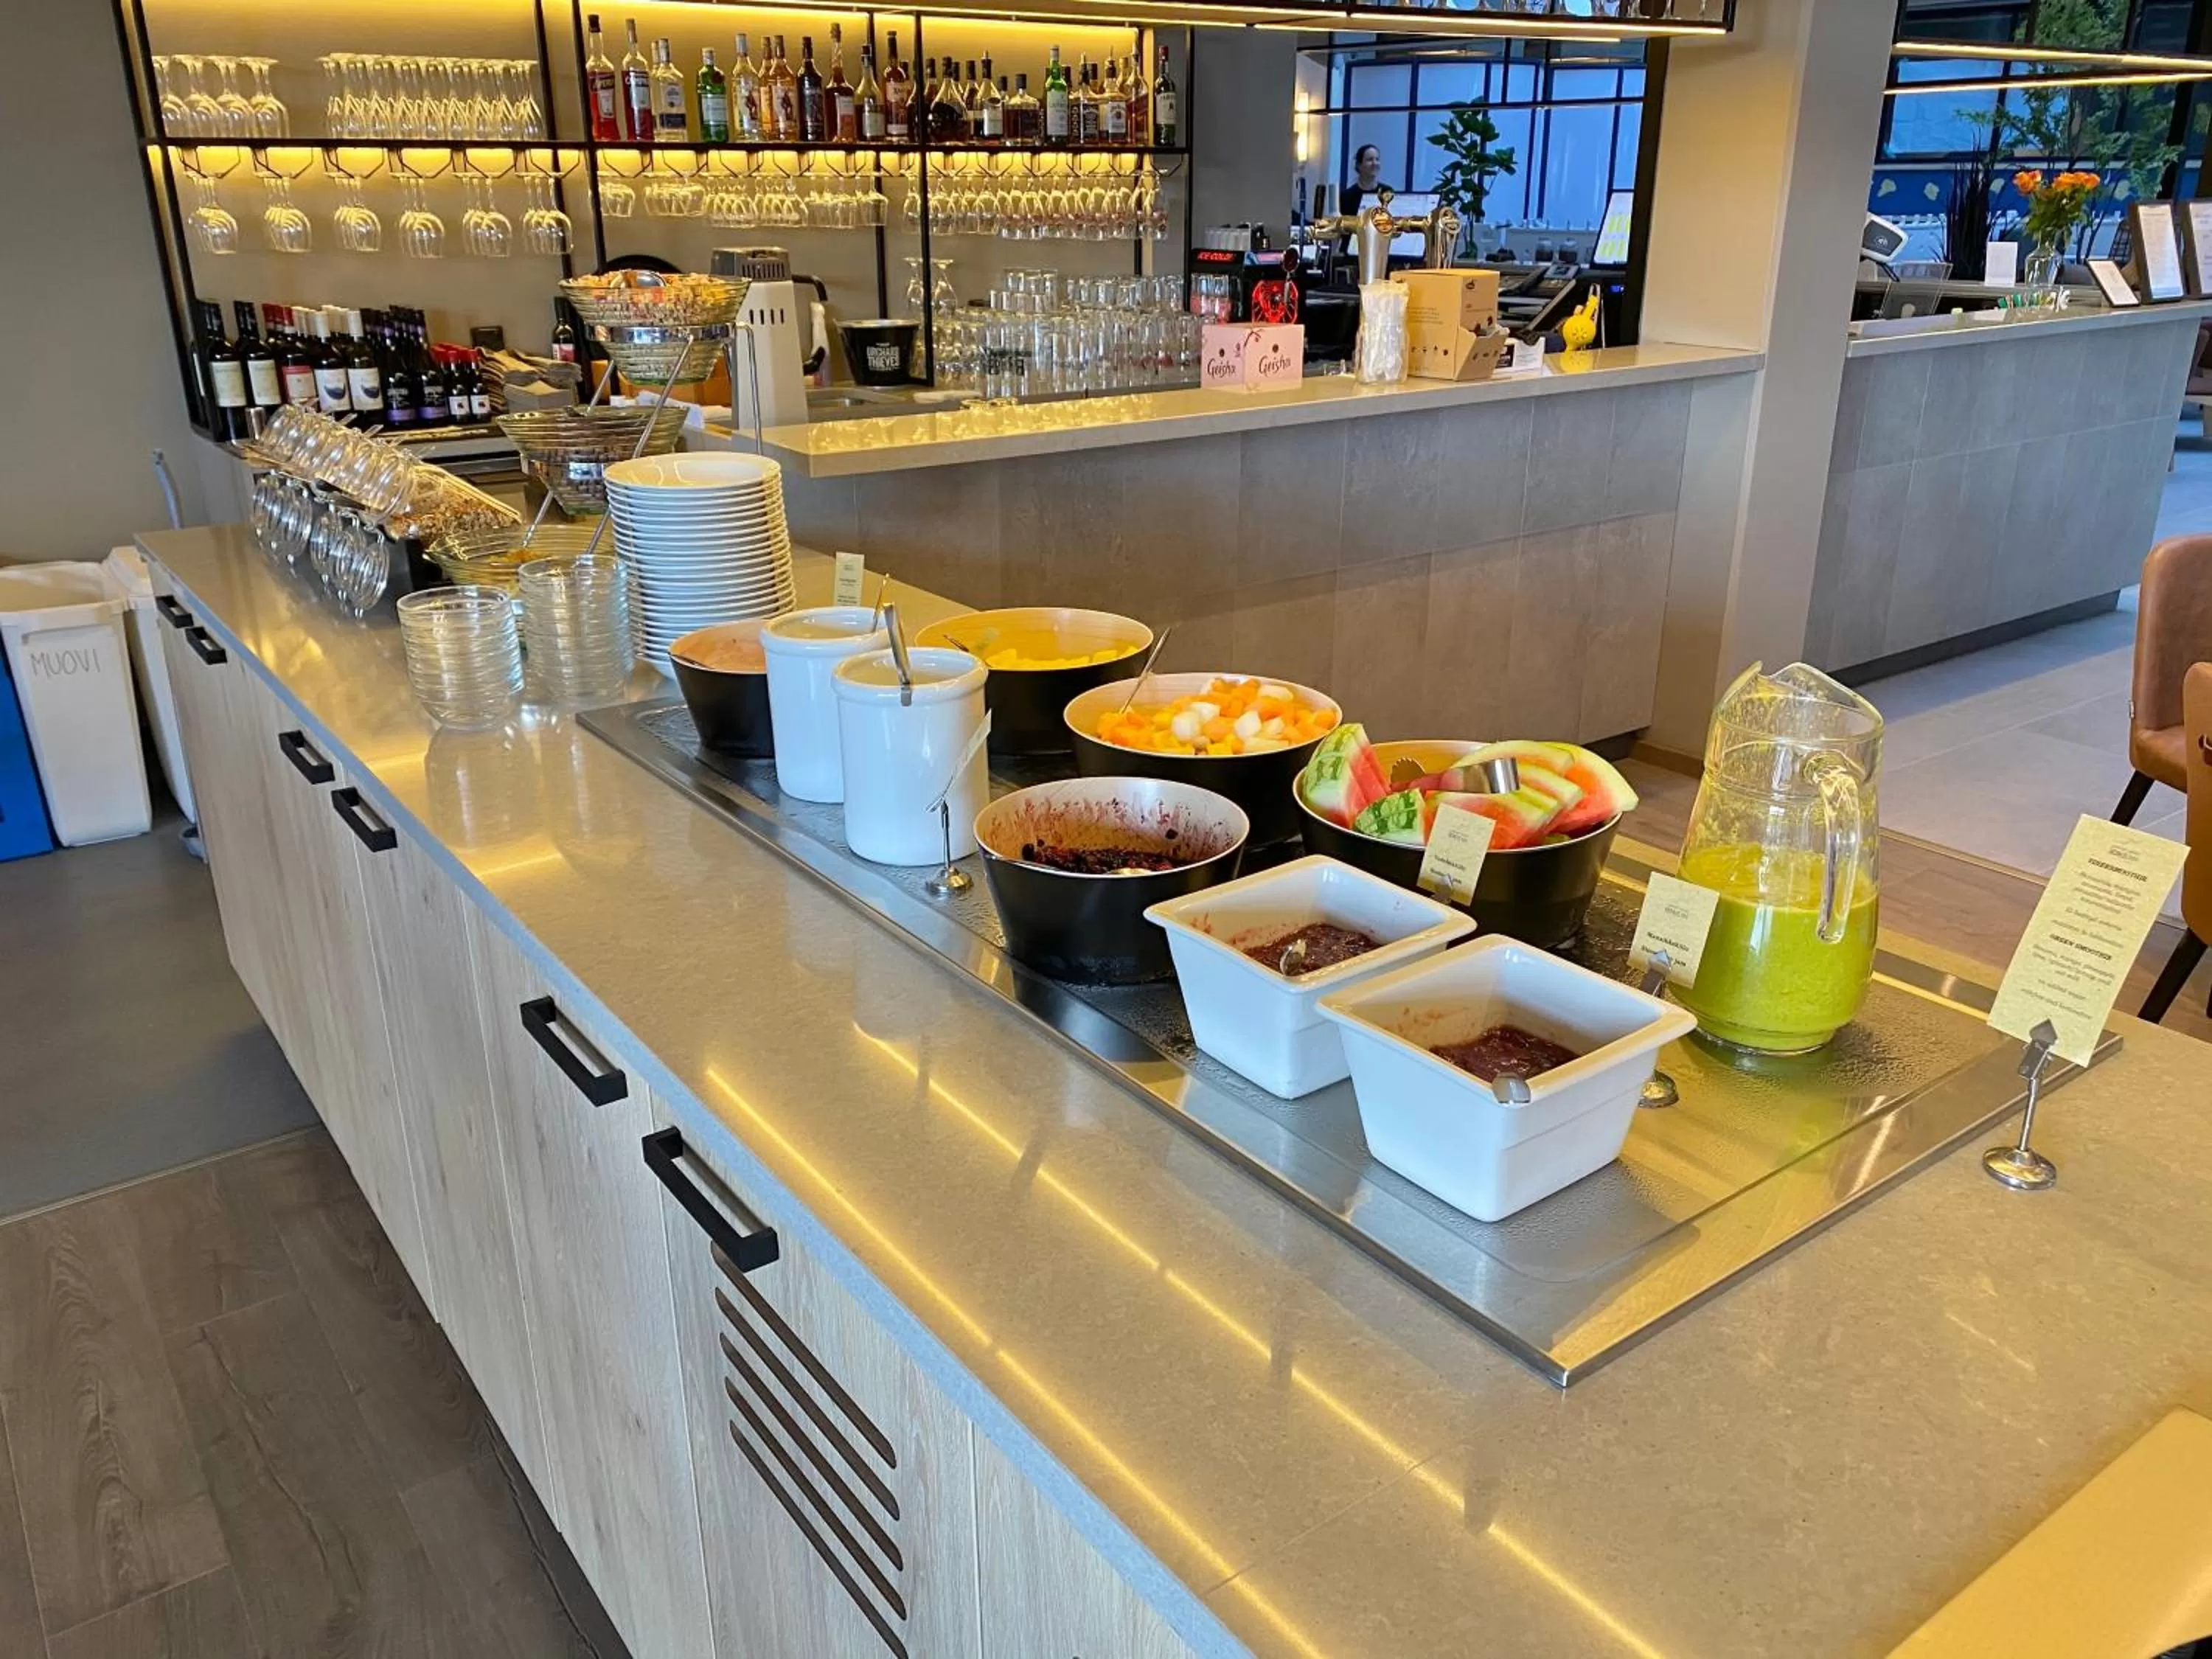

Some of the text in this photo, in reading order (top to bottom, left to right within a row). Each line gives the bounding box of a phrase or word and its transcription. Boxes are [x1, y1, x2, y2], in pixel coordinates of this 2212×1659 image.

[1207, 358, 1236, 379] Geisha
[1259, 354, 1291, 378] Geisha
[30, 648, 101, 677] MUOVI
